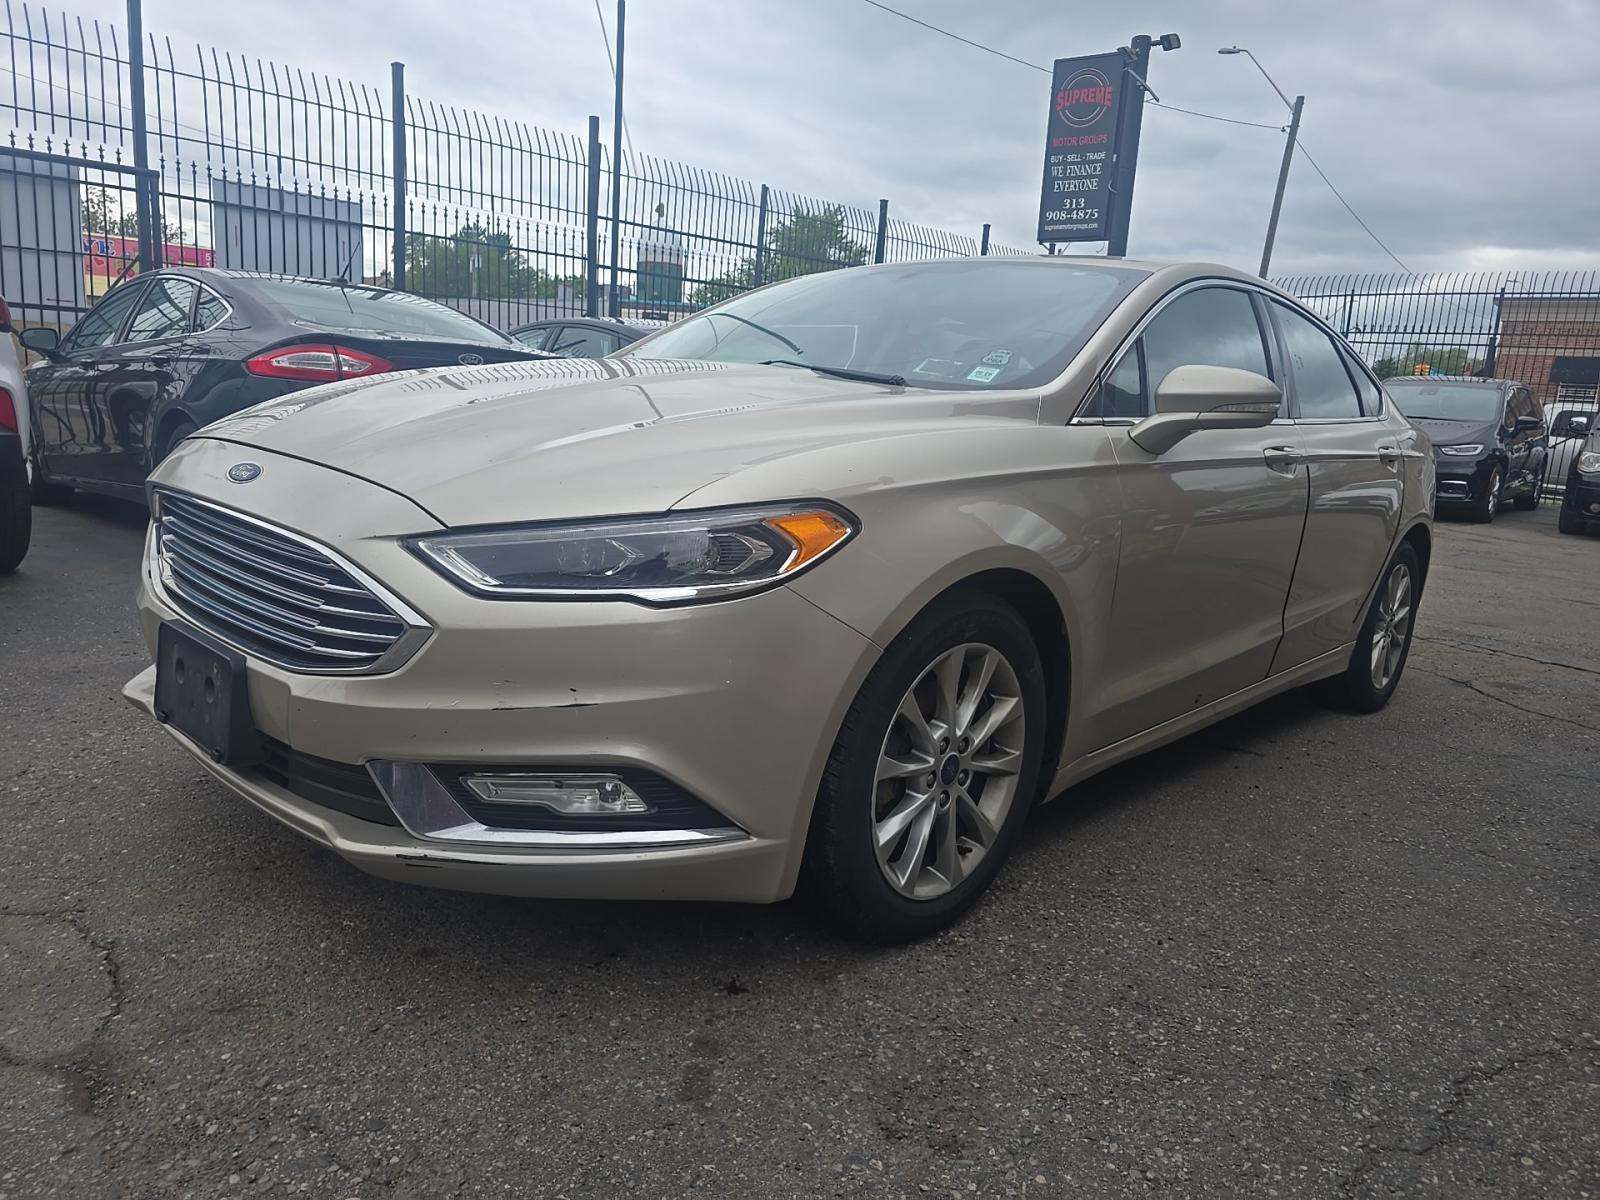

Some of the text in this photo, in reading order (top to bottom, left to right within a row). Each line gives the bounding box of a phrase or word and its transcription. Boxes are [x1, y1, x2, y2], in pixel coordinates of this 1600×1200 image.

[1056, 86, 1112, 110] SUPREME
[1053, 134, 1108, 146] MOTOR GROUPS
[1051, 163, 1102, 177] WE FINANCE
[1054, 178, 1099, 192] EVERYONE
[1062, 197, 1085, 209] 313
[1046, 209, 1099, 221] 908-4875
